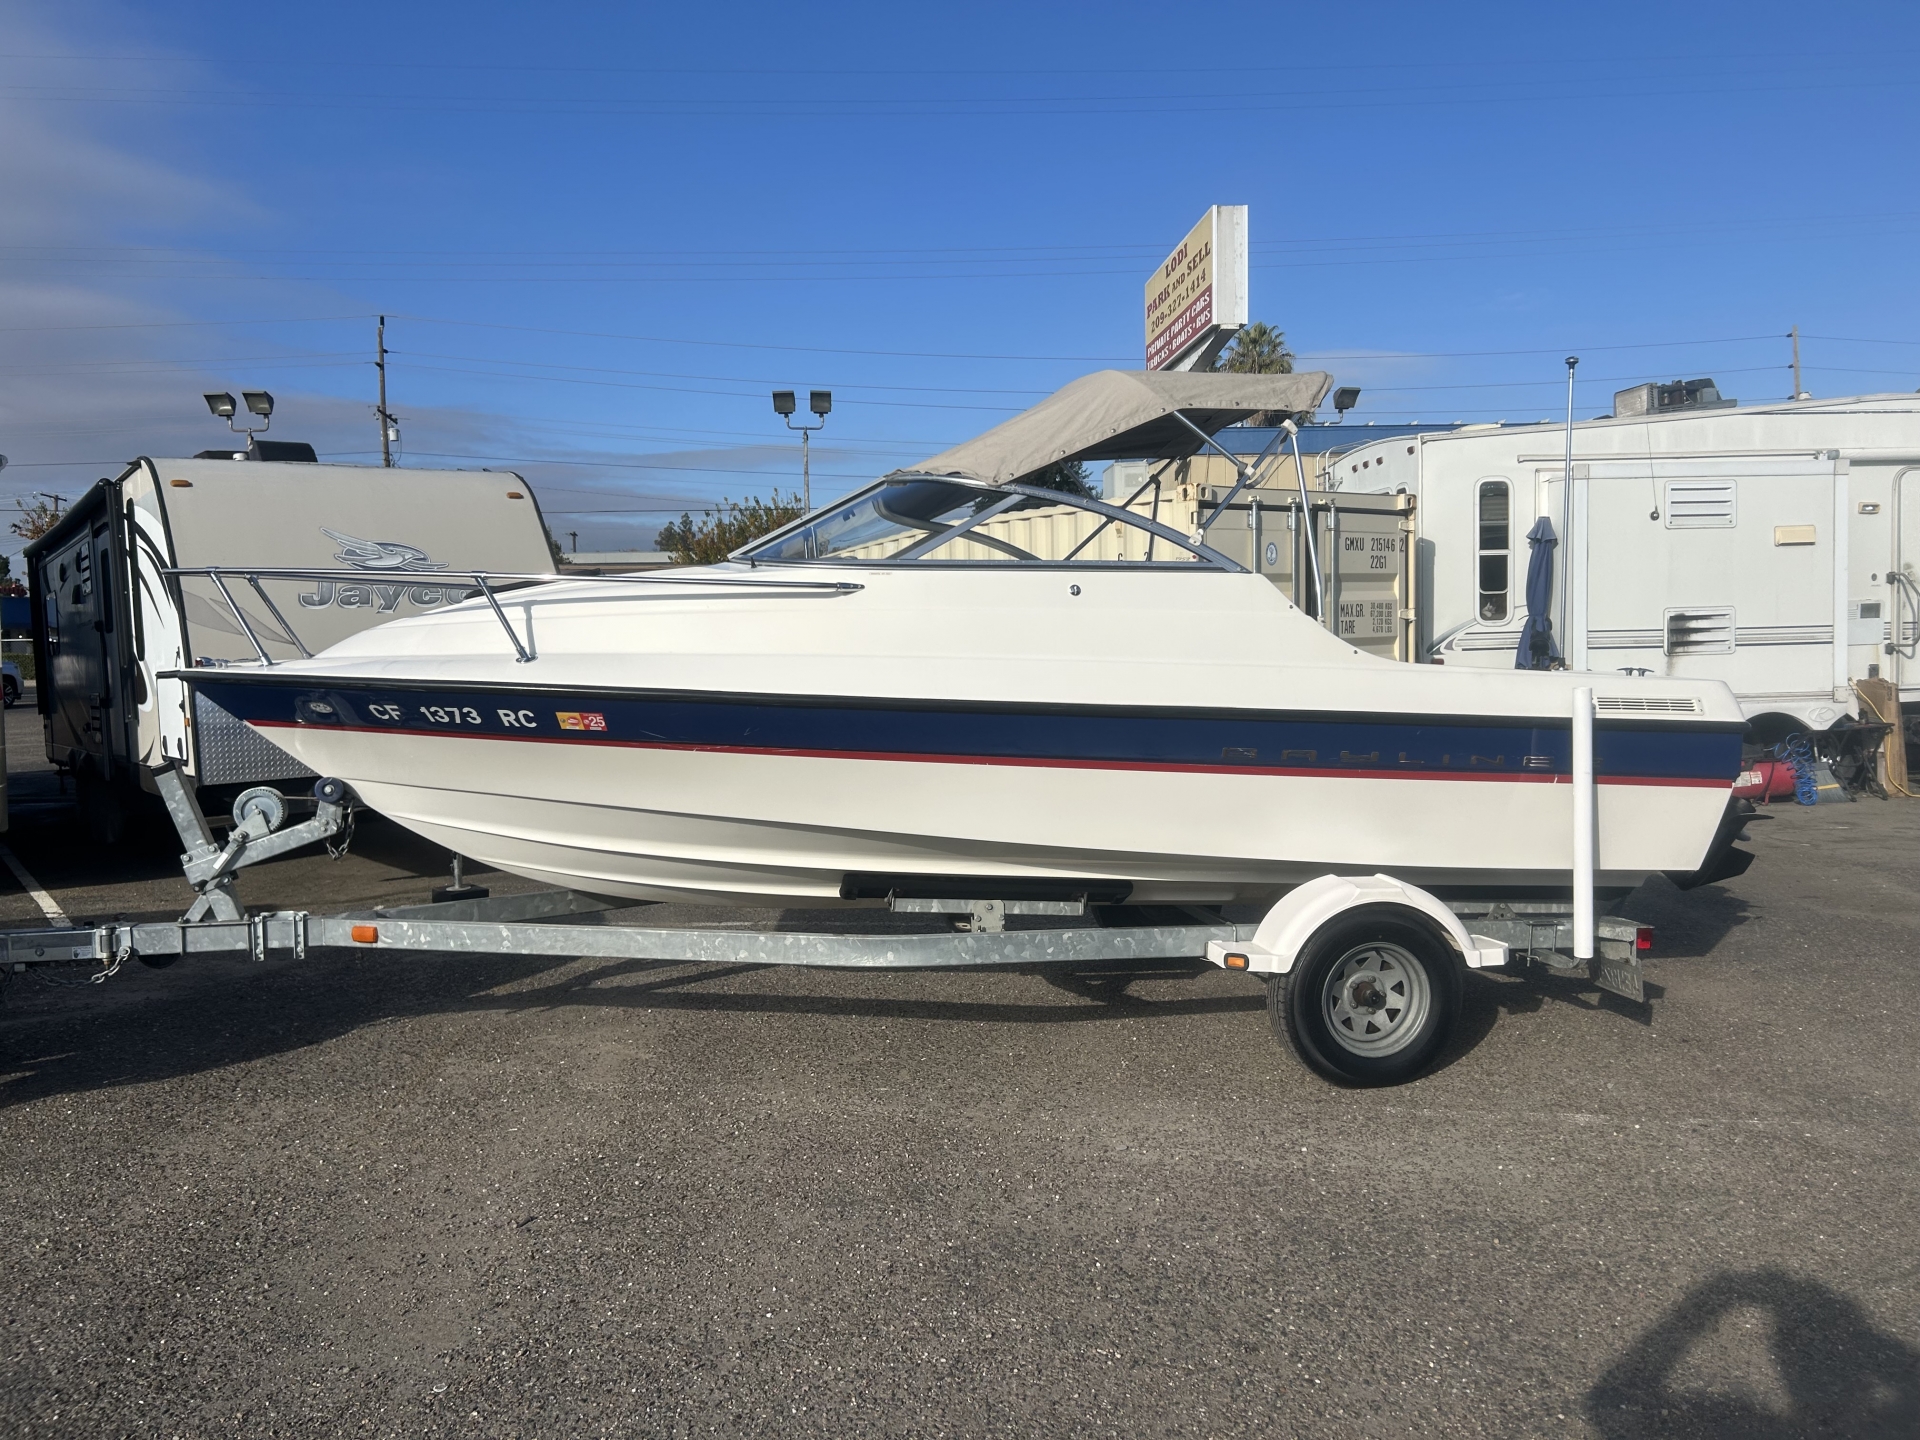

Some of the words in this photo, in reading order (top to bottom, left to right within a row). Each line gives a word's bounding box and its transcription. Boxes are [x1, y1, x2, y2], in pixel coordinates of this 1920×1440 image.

[1165, 242, 1188, 279] LODI
[1146, 283, 1171, 320] PARK
[1171, 272, 1186, 293] AND
[1187, 241, 1211, 277] SELL
[1147, 330, 1170, 358] PRIVATE
[1171, 309, 1191, 337] PARTY
[1191, 291, 1210, 317] CARS
[1147, 345, 1169, 371] TRUCKS
[1172, 324, 1193, 351] BOATS
[1344, 537, 1365, 551] GMXU
[1370, 537, 1396, 552] 215146
[1400, 537, 1405, 553] 2
[1370, 555, 1387, 569] 22G1
[1340, 620, 1356, 634] TARE
[368, 704, 402, 721] CF
[419, 706, 482, 724] 1373
[496, 709, 538, 728] RC
[588, 716, 606, 727] 25
